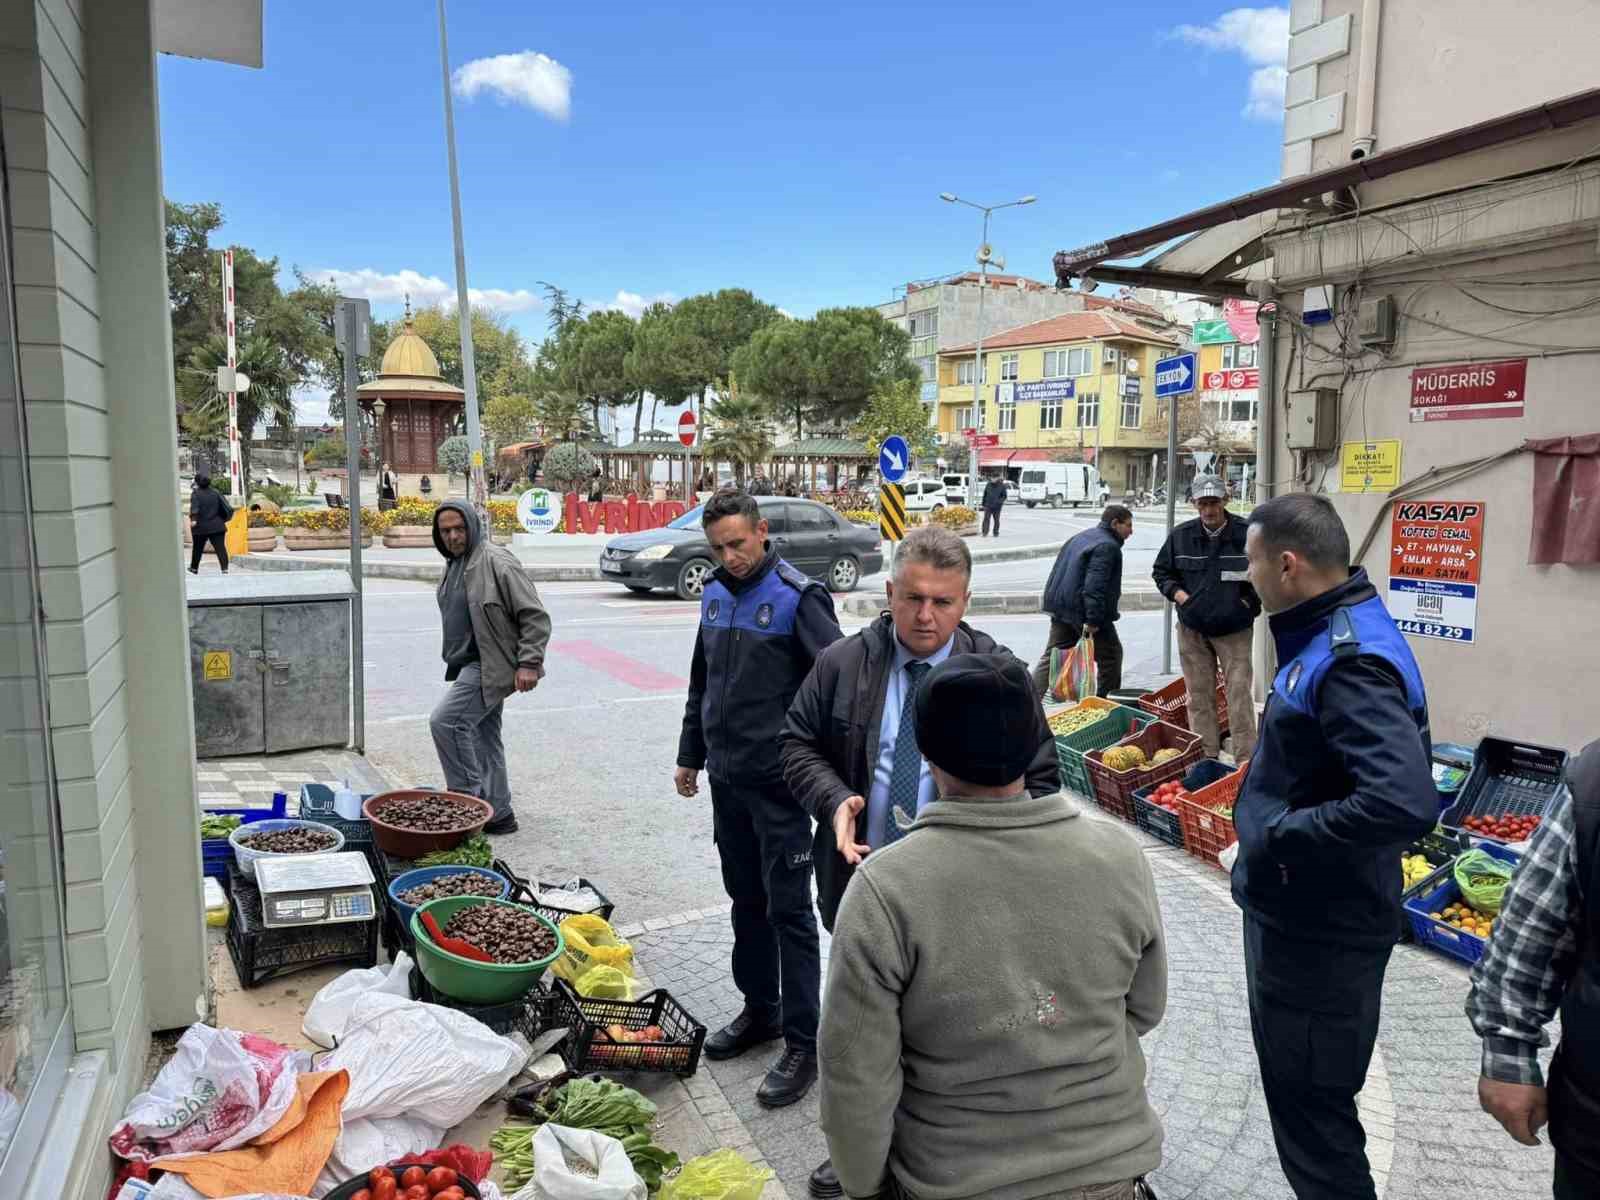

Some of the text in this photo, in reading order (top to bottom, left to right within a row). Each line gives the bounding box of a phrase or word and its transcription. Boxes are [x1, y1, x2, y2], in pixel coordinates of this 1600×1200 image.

[1416, 368, 1497, 391] MÜDERRİS
[1413, 393, 1448, 405] SOKAĞI
[1397, 503, 1479, 522] KASAP
[1441, 527, 1472, 542] CEMAL
[1407, 542, 1418, 551] ET
[1426, 543, 1464, 555] HAYVAN
[1402, 554, 1433, 565] EMLAK
[1440, 557, 1467, 568] ARSA
[1398, 565, 1425, 576] ALIM
[1435, 567, 1469, 580] SATIM
[1397, 620, 1420, 632] 444
[1424, 623, 1441, 635] 82
[1443, 627, 1464, 638] 29
